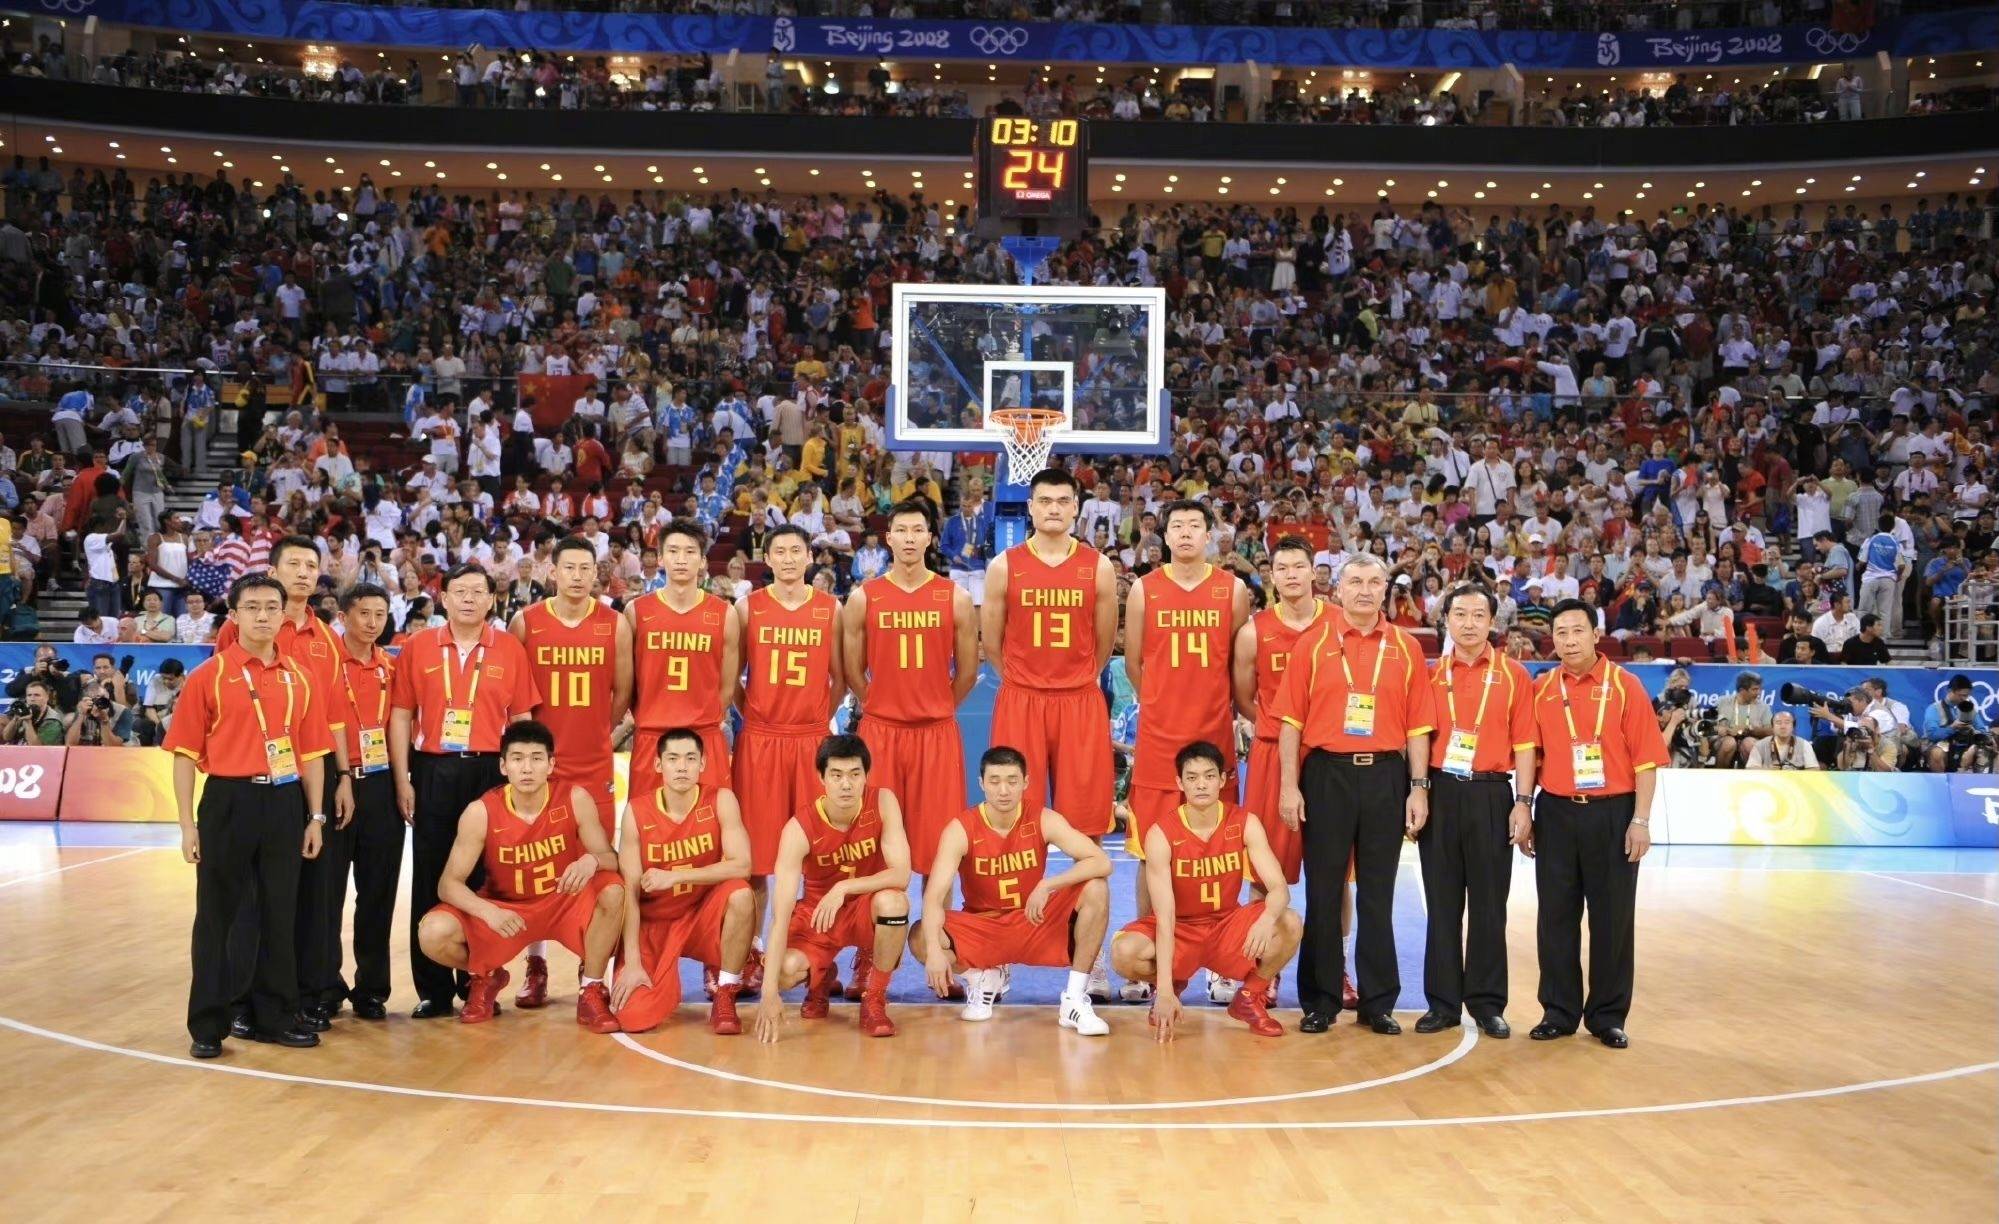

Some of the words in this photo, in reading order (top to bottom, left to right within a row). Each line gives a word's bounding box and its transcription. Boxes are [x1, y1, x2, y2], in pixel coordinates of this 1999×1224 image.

[820, 25, 894, 53] Beijing
[898, 30, 950, 48] 2008
[1645, 35, 1722, 63] Beijing
[1727, 34, 1783, 53] 2008
[1004, 150, 1064, 189] 24
[1025, 191, 1051, 199] OMEGA
[1022, 588, 1084, 608] CHINA
[878, 610, 941, 629] CHINA
[1033, 611, 1071, 648] 13
[1157, 609, 1220, 628] CHINA
[647, 631, 712, 653] CHINA
[759, 625, 822, 647] CHINA
[899, 633, 924, 669] 11
[1171, 631, 1209, 668] 14
[537, 646, 605, 666] CHINA
[769, 648, 808, 687] 15
[667, 655, 689, 691] 9
[550, 671, 591, 707] 10
[499, 833, 567, 865] CHINA
[647, 832, 714, 863] CHINA
[816, 836, 877, 867] CHINA
[975, 847, 1038, 877] CHINA
[514, 861, 556, 896] 12
[1176, 851, 1241, 878] CHINA
[998, 877, 1021, 909] 5
[1200, 881, 1221, 912] 4
